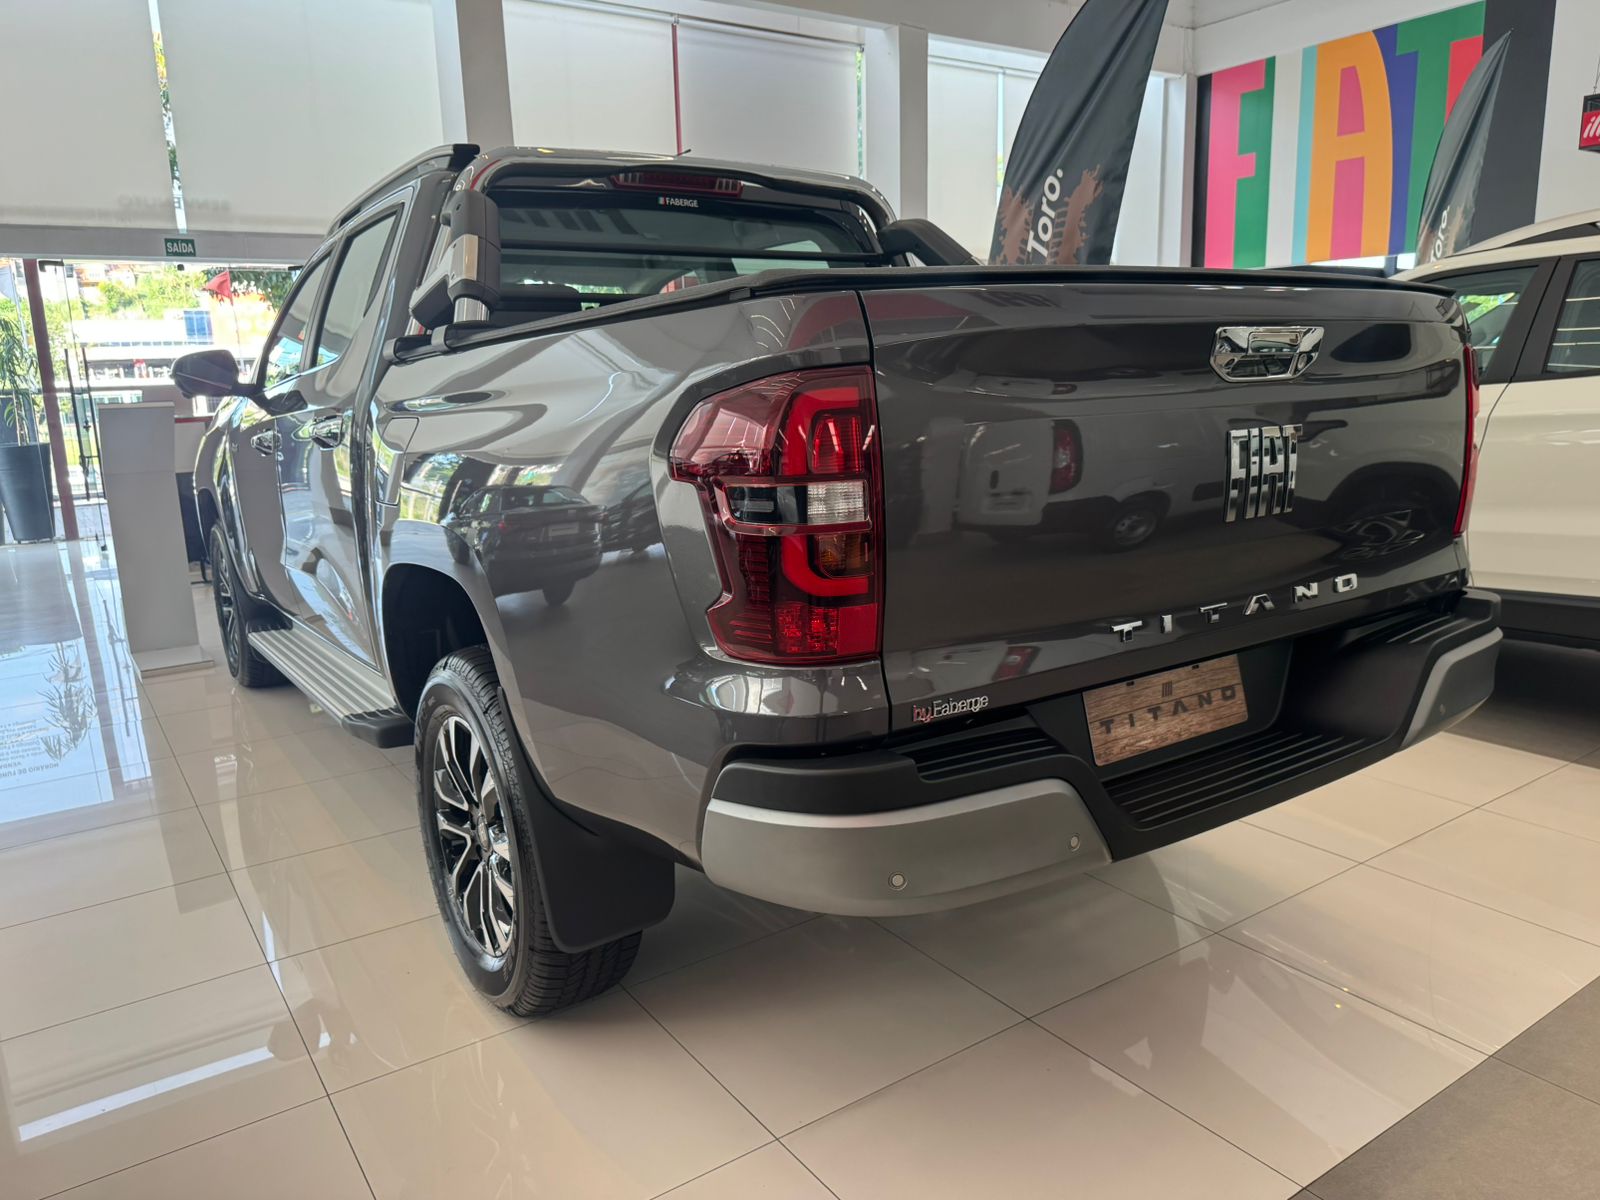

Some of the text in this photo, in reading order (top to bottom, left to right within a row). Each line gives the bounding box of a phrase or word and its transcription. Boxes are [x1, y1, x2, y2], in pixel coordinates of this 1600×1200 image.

[1204, 1, 1486, 269] FIAT
[665, 197, 699, 208] FABERGE
[1027, 168, 1064, 258] Toro.
[166, 240, 194, 254] SAÍDA
[1225, 423, 1303, 523] FIAT
[1110, 572, 1359, 643] TITANO
[933, 695, 989, 717] Faberge
[1099, 685, 1237, 735] TITANO
